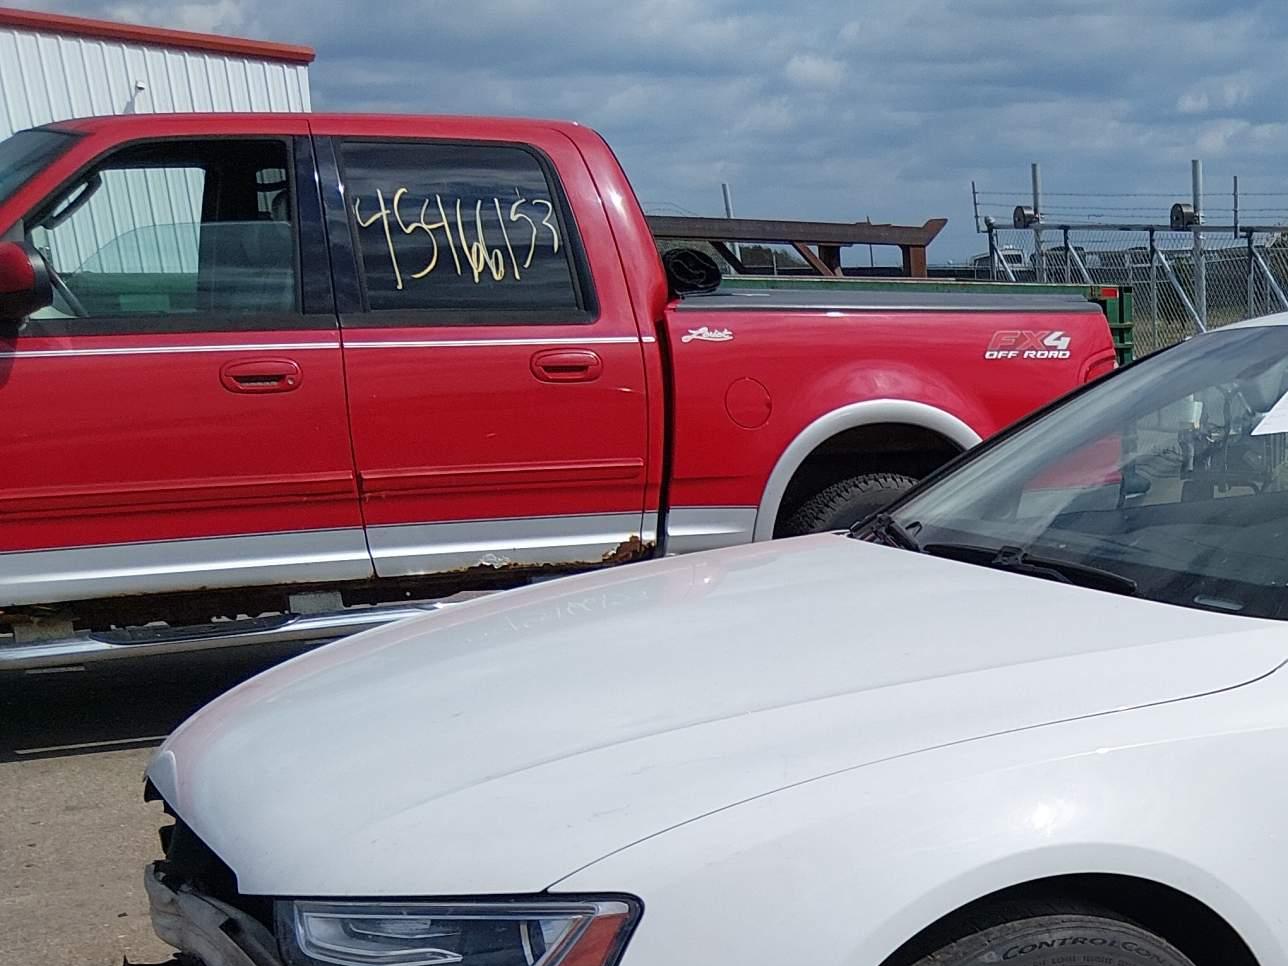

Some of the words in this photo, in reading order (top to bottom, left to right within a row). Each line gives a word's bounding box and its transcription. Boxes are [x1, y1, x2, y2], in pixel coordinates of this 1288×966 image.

[354, 187, 560, 290] 45466153
[986, 329, 1072, 350] FX4
[984, 350, 1020, 359] OFF
[1023, 350, 1071, 359] ROAD
